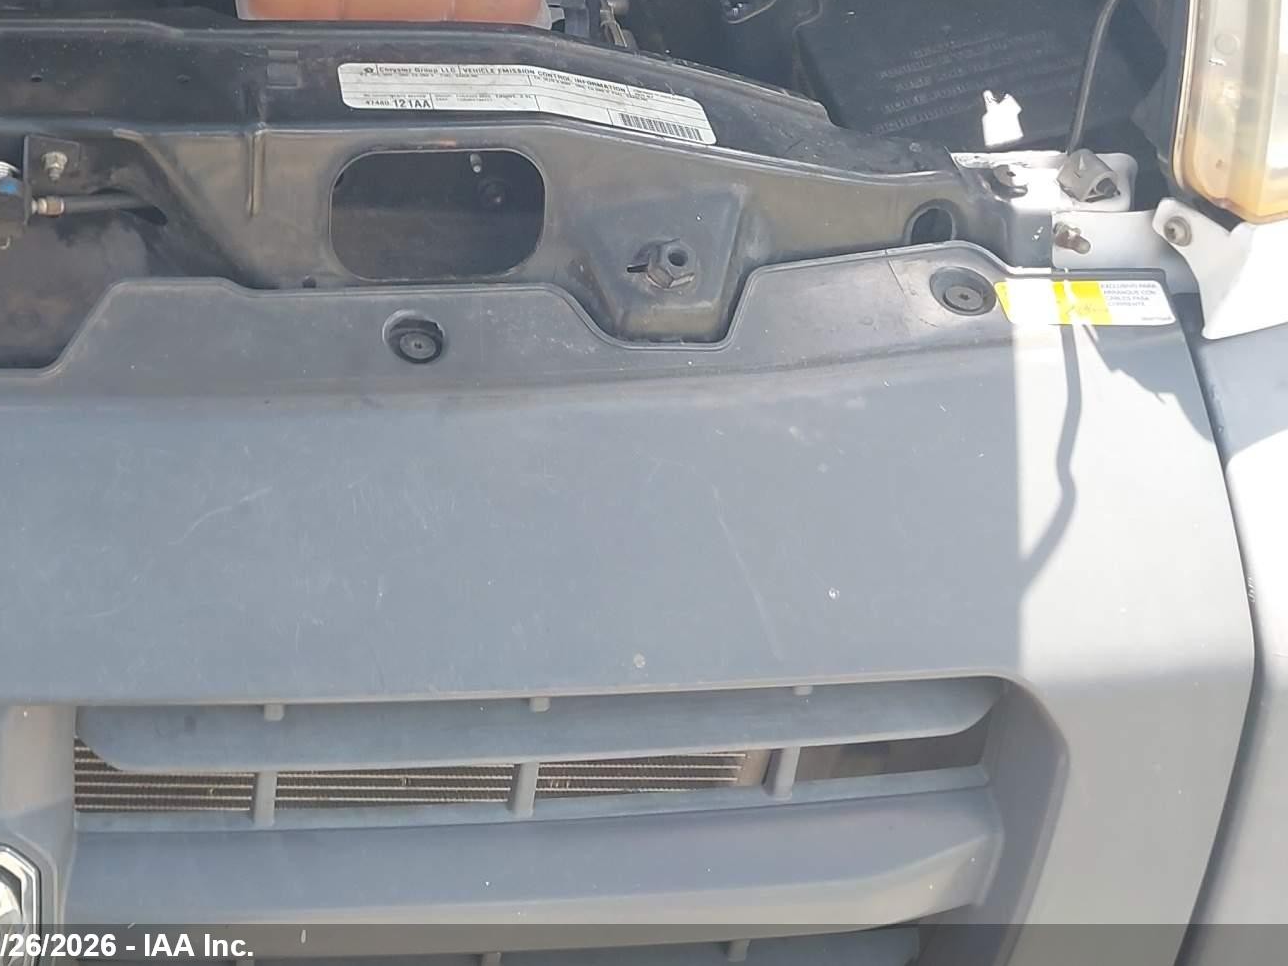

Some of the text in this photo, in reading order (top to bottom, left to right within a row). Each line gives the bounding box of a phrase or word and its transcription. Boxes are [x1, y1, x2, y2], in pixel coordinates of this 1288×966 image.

[414, 67, 439, 75] Group
[537, 72, 572, 82] CONTROL
[573, 77, 626, 93] INFORMATION
[393, 98, 431, 109] 121AA
